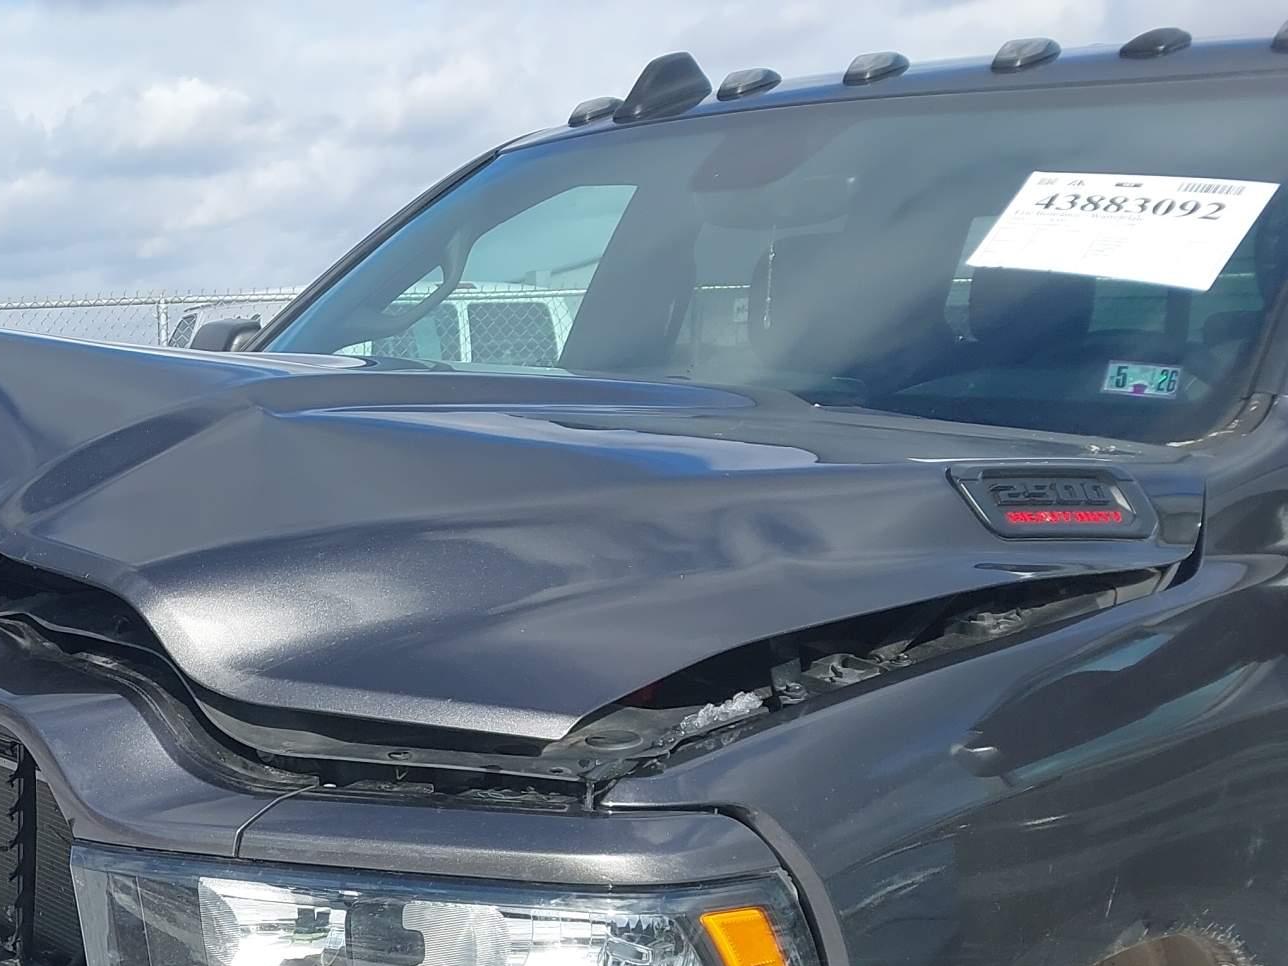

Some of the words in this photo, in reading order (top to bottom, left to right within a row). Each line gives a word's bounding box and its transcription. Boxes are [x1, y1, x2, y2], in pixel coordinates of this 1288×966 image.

[1035, 192, 1227, 221] 43883092
[1115, 366, 1129, 388] 5
[1157, 369, 1179, 392] 26
[989, 483, 1111, 506] 2500
